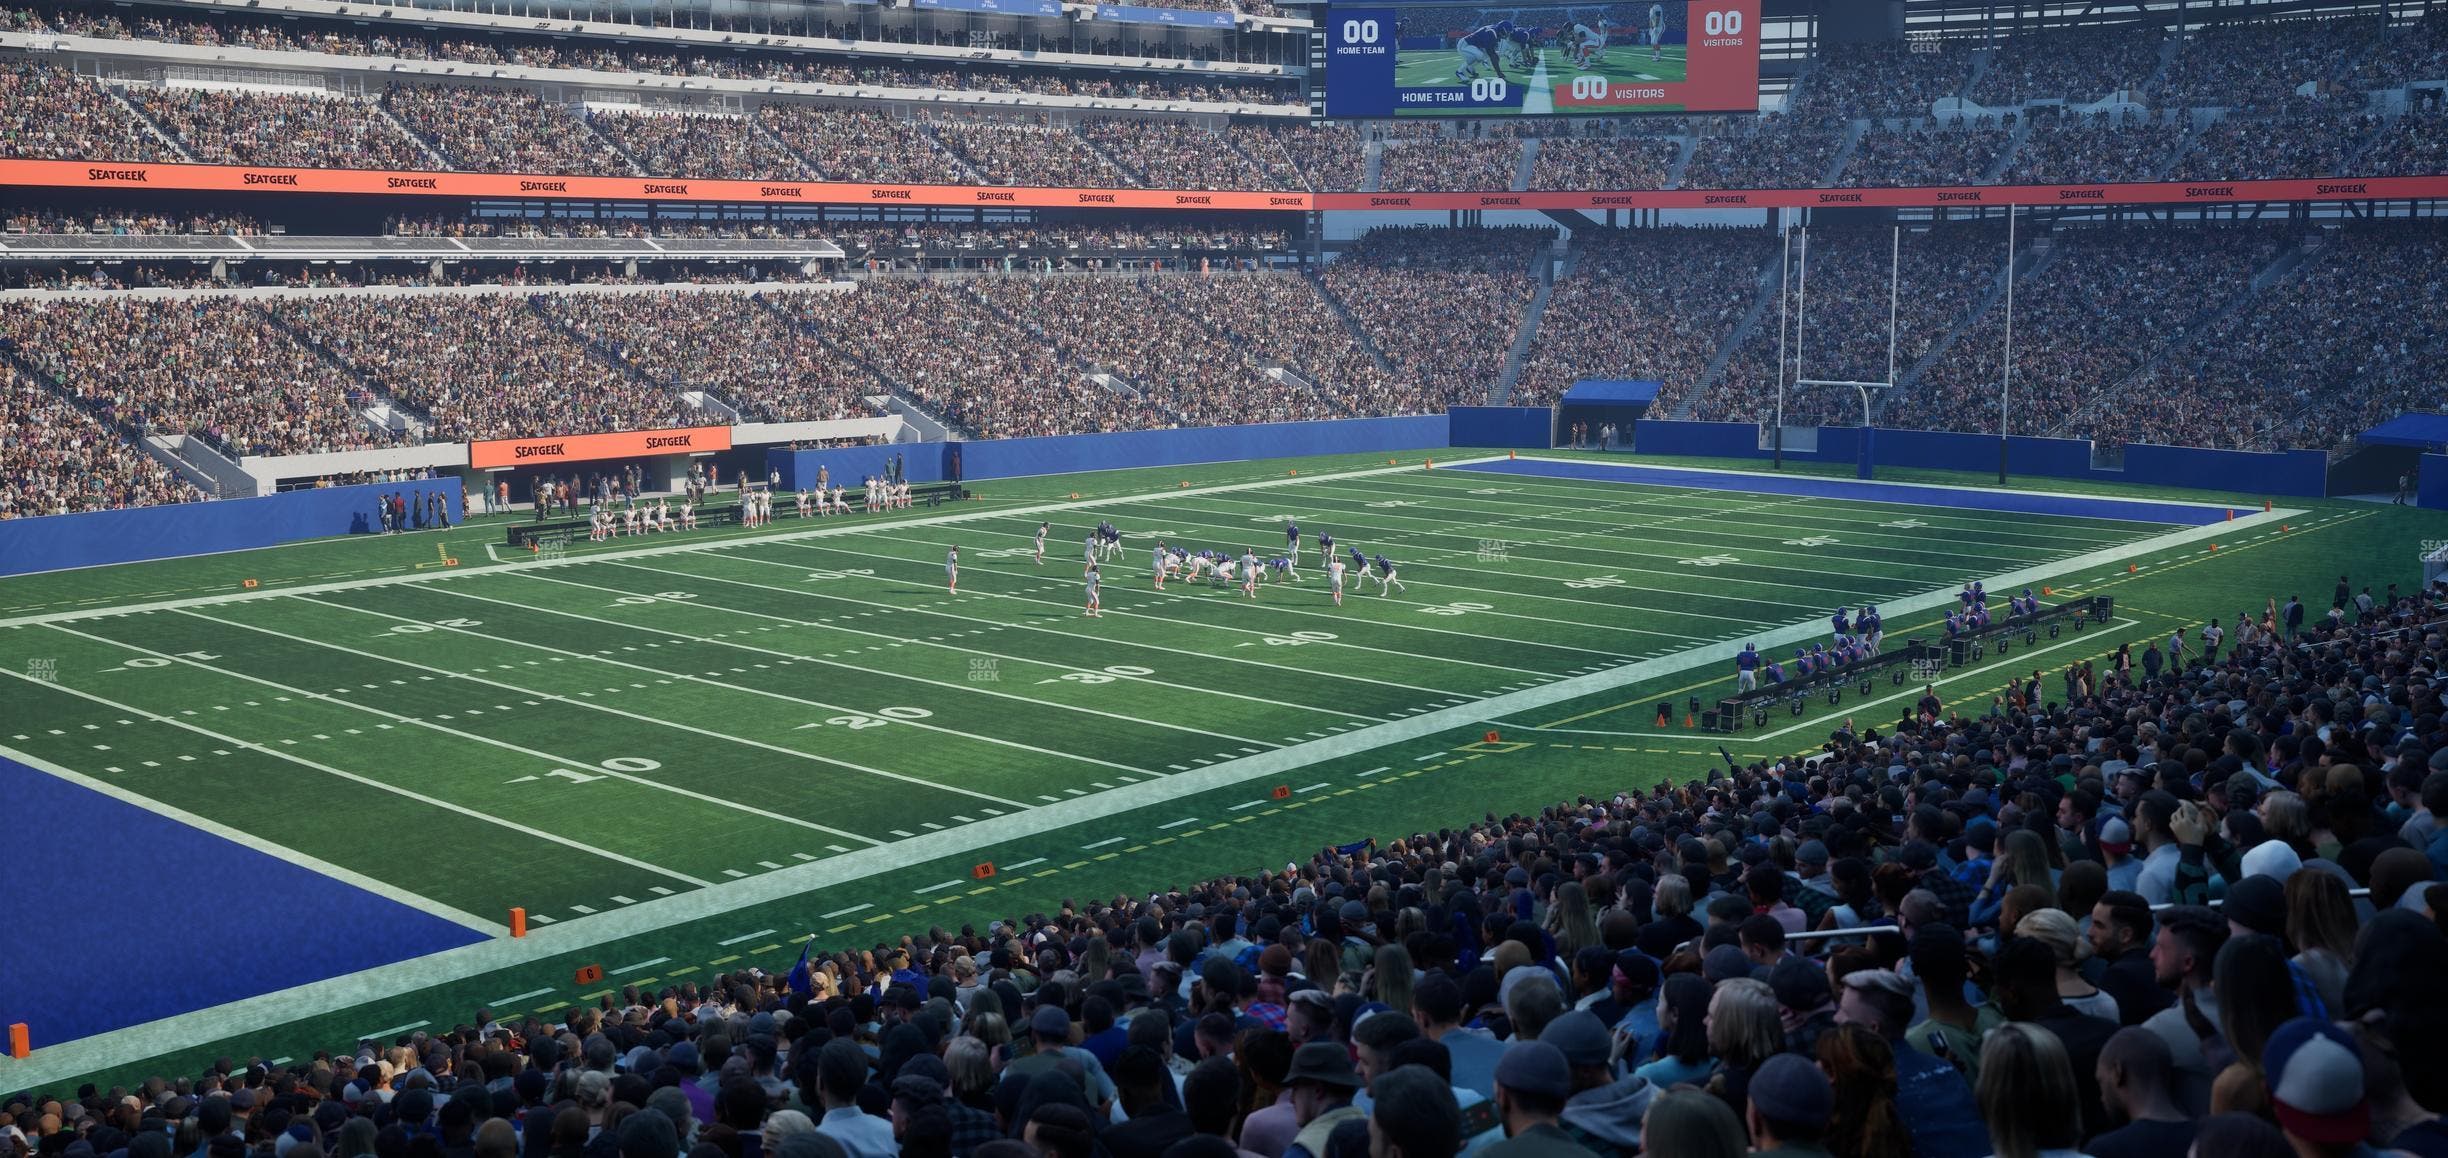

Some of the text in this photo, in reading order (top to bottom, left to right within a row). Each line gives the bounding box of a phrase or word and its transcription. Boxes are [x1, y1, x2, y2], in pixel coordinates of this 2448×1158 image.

[1705, 10, 1742, 36] 00
[1343, 20, 1379, 44] 00
[1703, 38, 1743, 47] VISITORS
[1402, 78, 1506, 102] HOME TEAM 00
[1572, 75, 1664, 100] 00 VISITORS
[89, 168, 147, 182] SEATGEEK
[243, 172, 298, 186] SEATGEEK
[388, 177, 436, 190] SEATGEEK
[520, 180, 566, 193] SEATGEEK
[2316, 184, 2366, 194] SEATGEEK
[644, 184, 688, 195] SEATGEEK
[761, 186, 801, 198] SEATGEEK
[872, 190, 911, 200] SEATGEEK
[2060, 190, 2104, 200] SEATGEEK
[2186, 186, 2234, 198] SEATGEEK
[977, 192, 1015, 202] SEATGEEK
[1079, 194, 1115, 204] SEATGEEK
[1176, 196, 1211, 205] SEATGEEK
[1270, 197, 1302, 206] SEATGEEK
[1371, 197, 1411, 206] SEATGEEK
[1480, 196, 1521, 206] SEATGEEK
[1592, 196, 1632, 205] SEATGEEK
[1704, 194, 1746, 204] SEATGEEK
[1820, 194, 1862, 203] SEATGEEK
[1937, 192, 1981, 202] SEATGEEK
[646, 435, 692, 450] SEATGEEK
[515, 443, 565, 458] SEATGEEK
[1416, 602, 1494, 616] 50
[1263, 631, 1339, 646] 40
[1060, 666, 1155, 684] 30
[826, 706, 934, 730] 20
[544, 757, 662, 784] 10
[981, 864, 990, 874] 10
[586, 968, 594, 979] G
